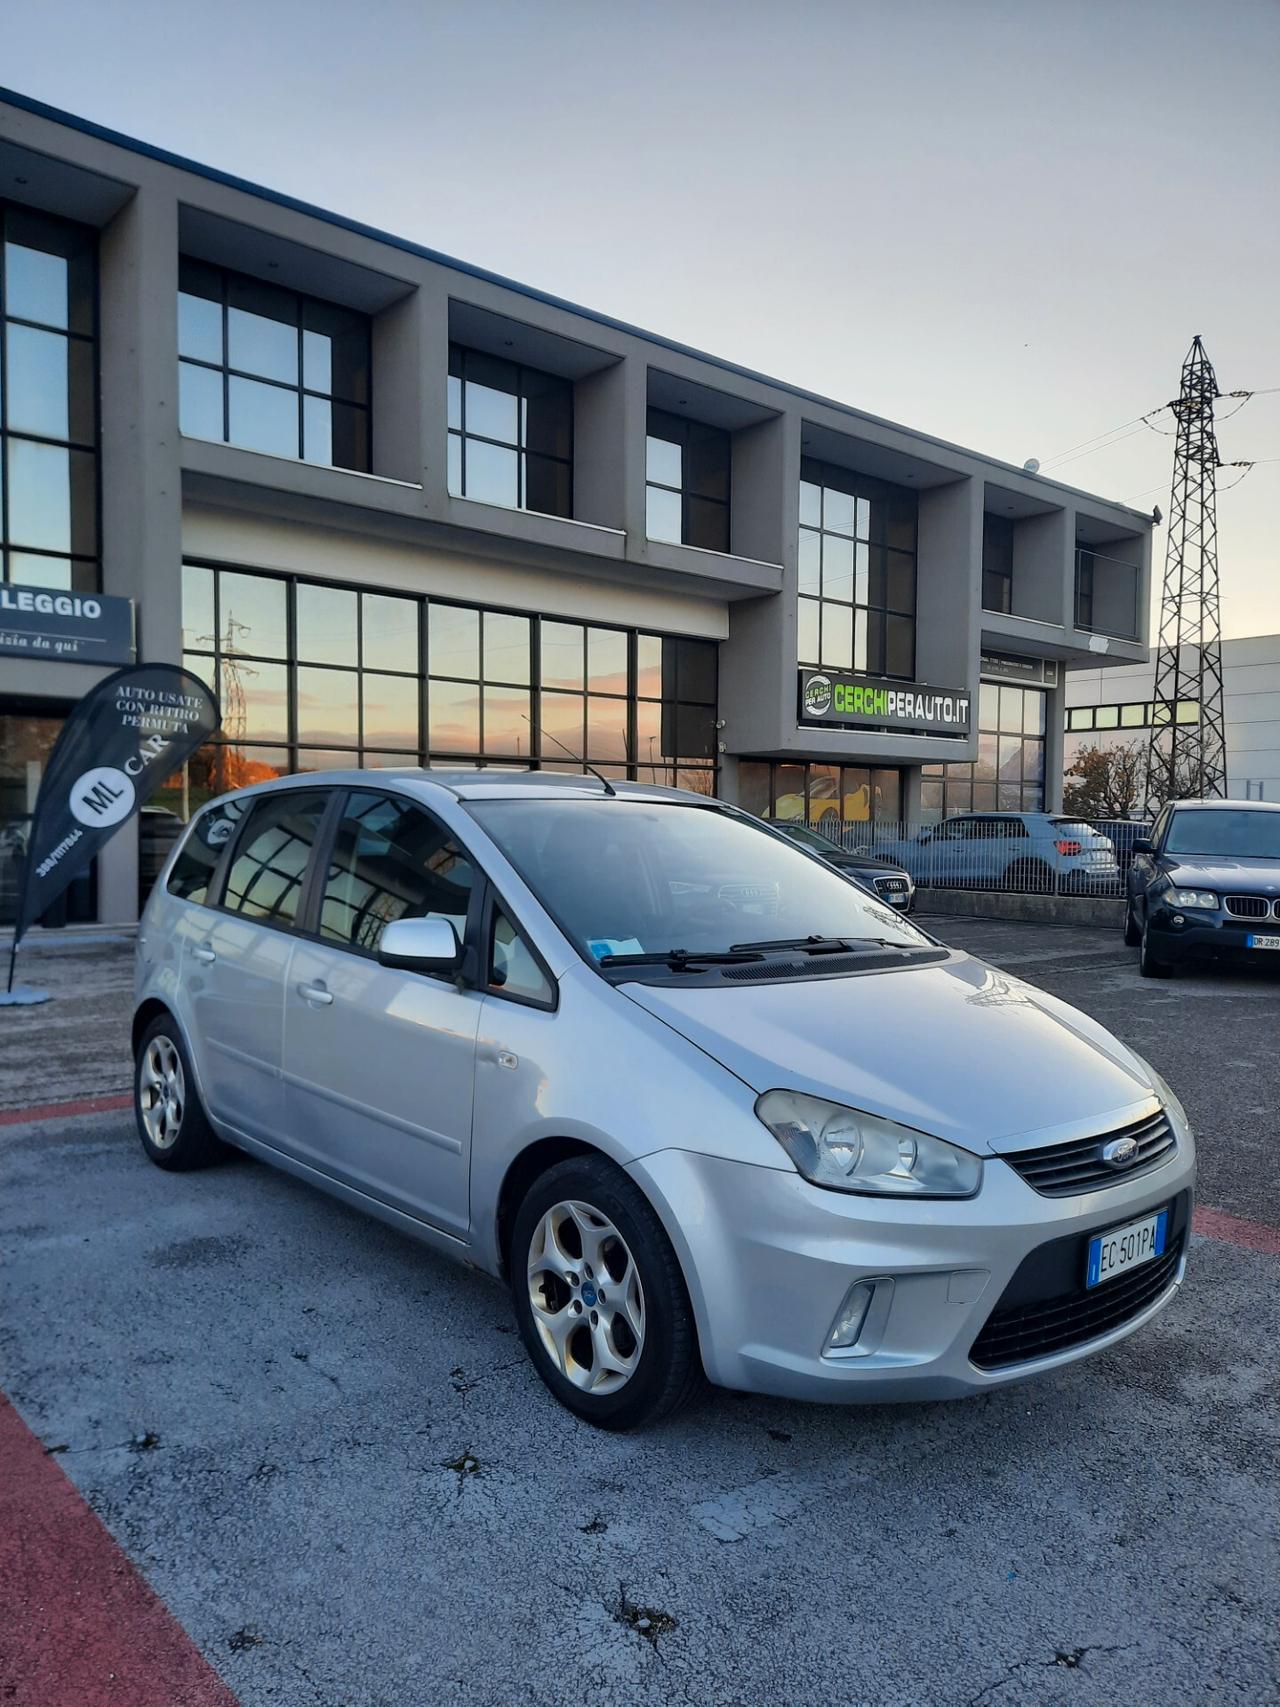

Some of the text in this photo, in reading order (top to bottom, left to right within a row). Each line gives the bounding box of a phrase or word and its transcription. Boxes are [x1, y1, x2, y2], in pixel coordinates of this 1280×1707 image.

[0, 589, 102, 619] LEGGIO
[32, 636, 51, 649] da
[115, 686, 204, 709] AUTO USATE
[805, 692, 832, 707] PER AUTO
[116, 700, 200, 721] CON RITIRO
[121, 714, 189, 734] PERMUTA
[82, 734, 170, 815] ML CAR
[1101, 1240, 1117, 1273] EC
